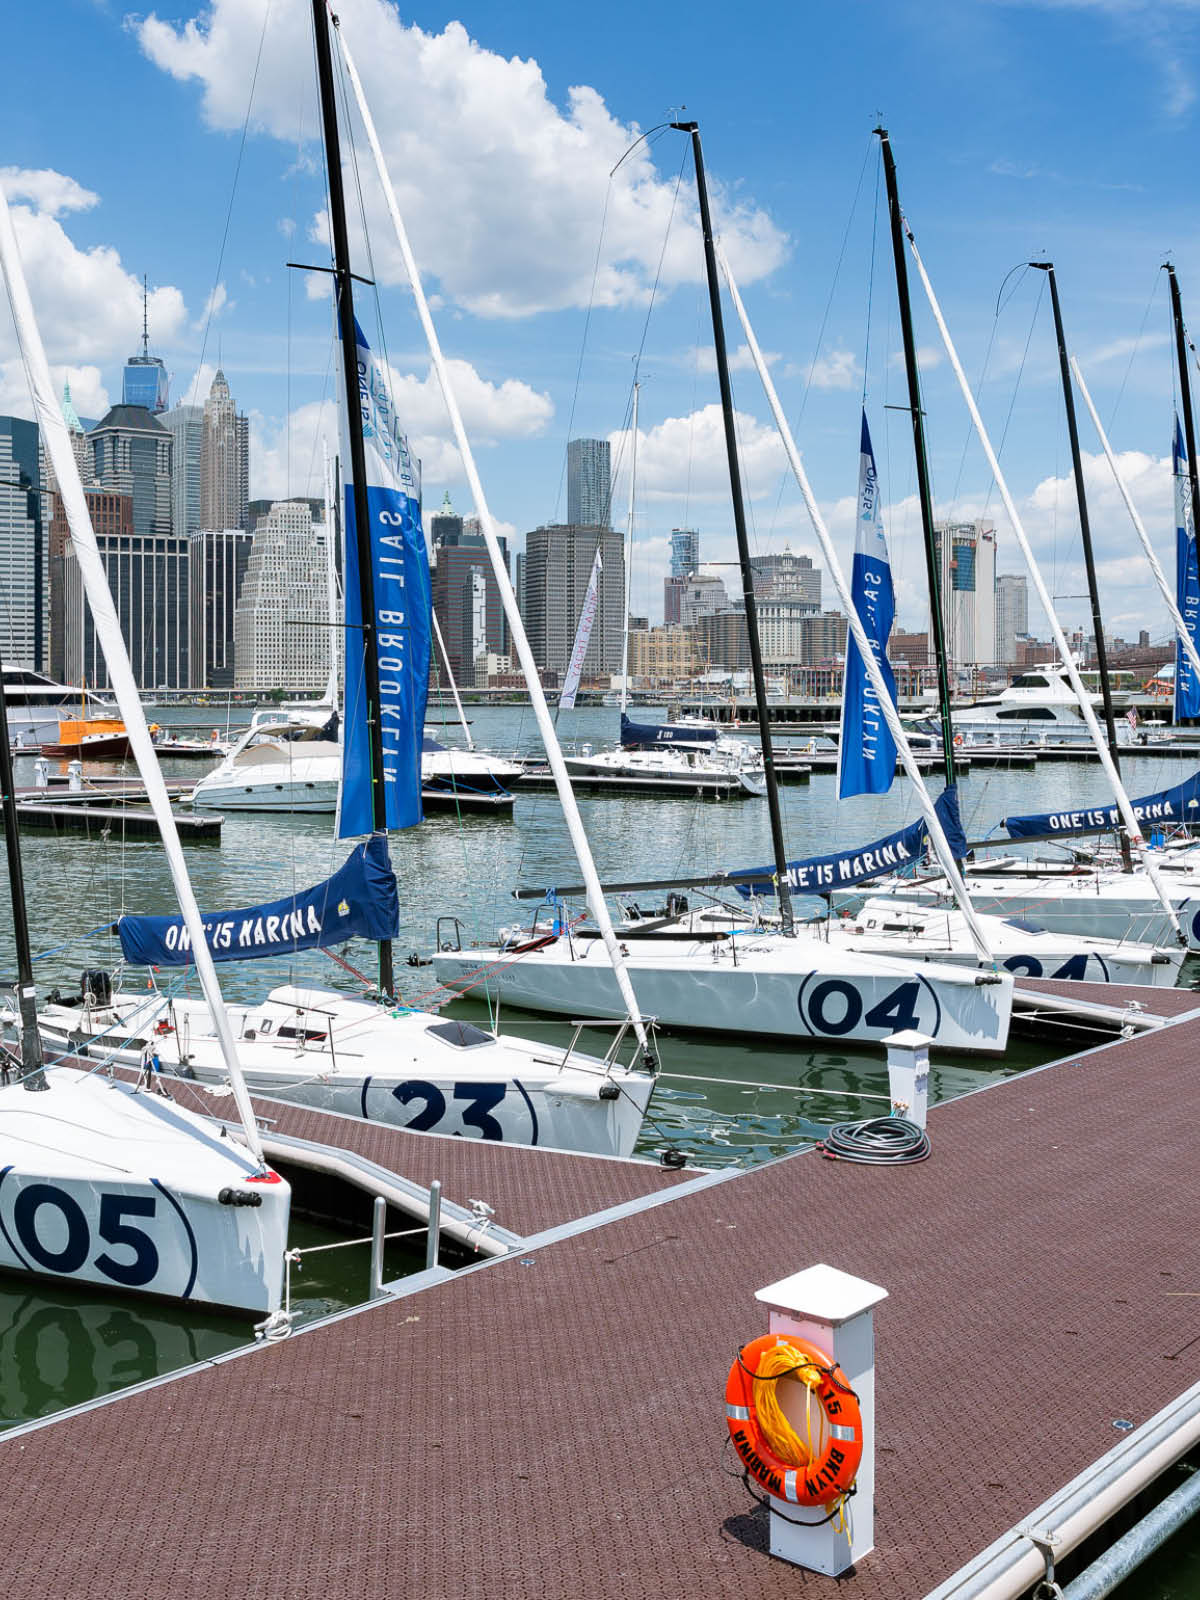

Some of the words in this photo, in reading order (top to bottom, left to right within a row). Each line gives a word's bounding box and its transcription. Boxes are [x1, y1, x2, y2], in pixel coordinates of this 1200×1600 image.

[1110, 801, 1174, 825] MRINA
[838, 841, 911, 881] MARINA
[239, 905, 322, 948] MARINA
[823, 1388, 842, 1415] 15
[733, 1430, 782, 1493] MARINA
[806, 1447, 845, 1497] BKLYN
